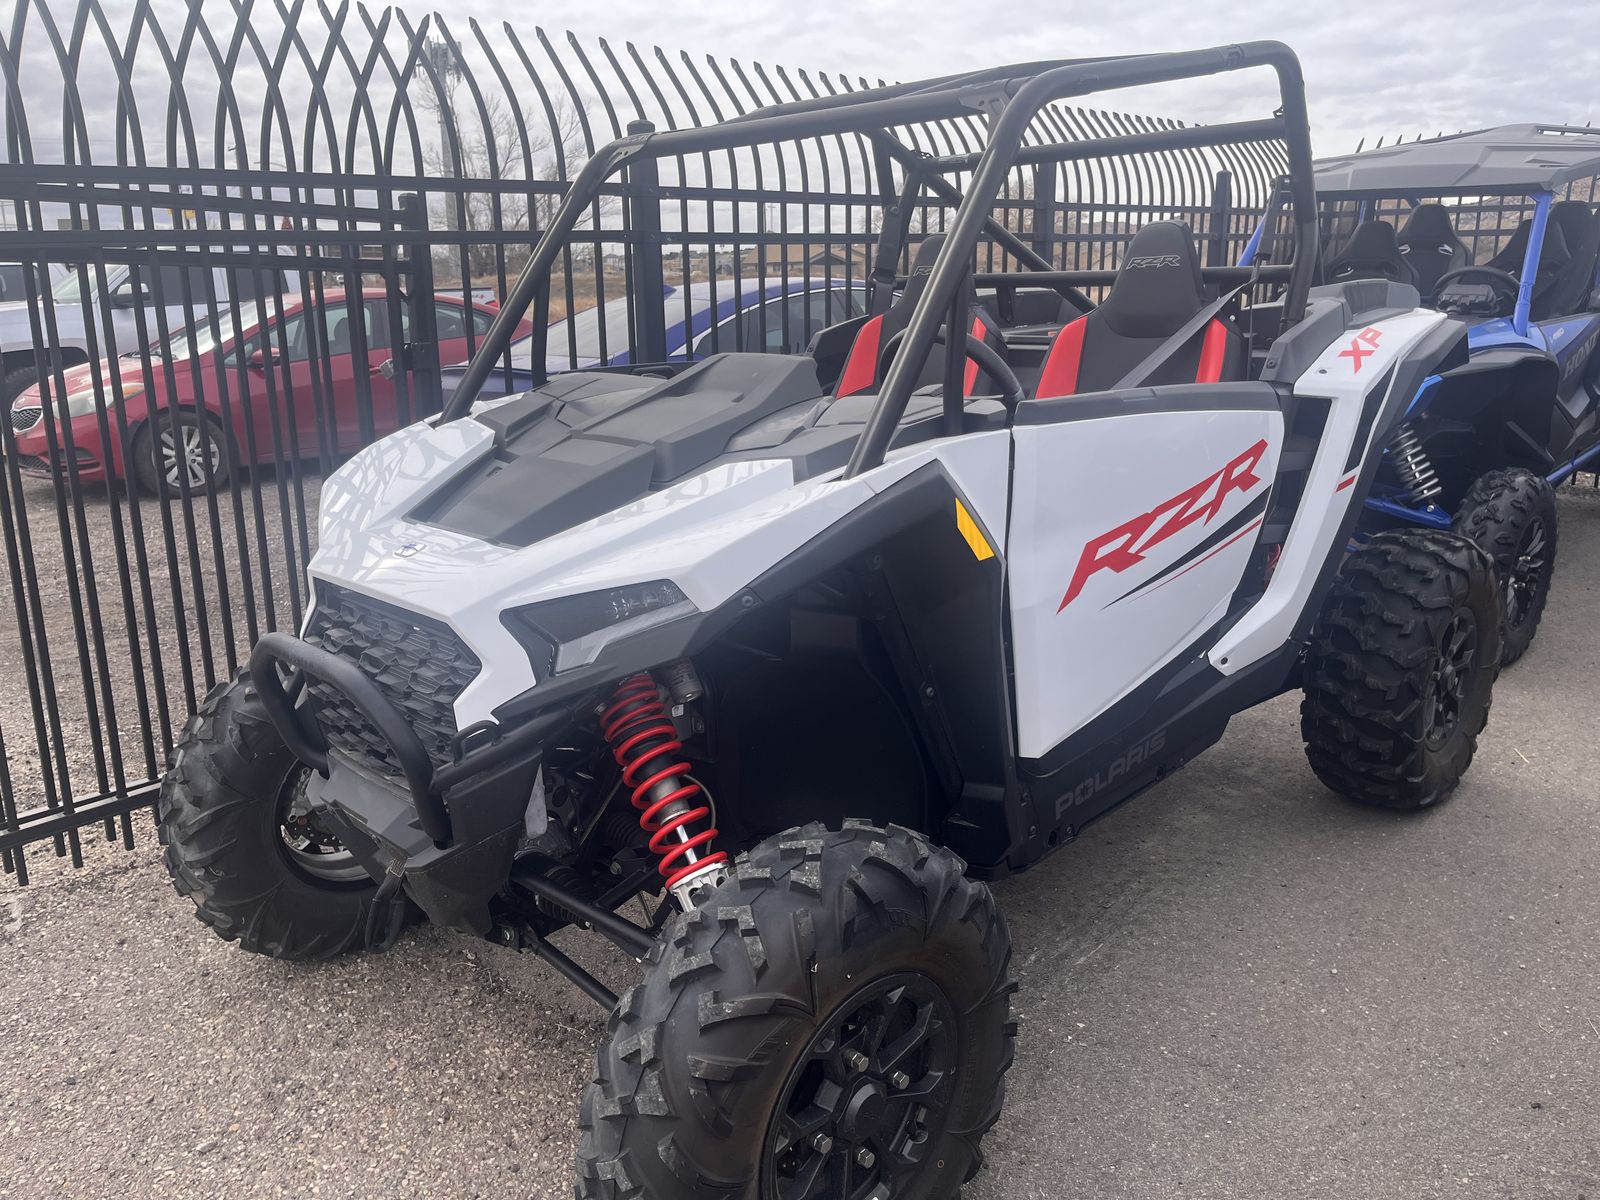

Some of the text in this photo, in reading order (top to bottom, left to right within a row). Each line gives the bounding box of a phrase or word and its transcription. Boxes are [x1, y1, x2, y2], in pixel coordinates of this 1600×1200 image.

[1126, 255, 1181, 270] RZR
[1338, 327, 1383, 376] XP
[1056, 438, 1269, 616] RZR
[1055, 729, 1167, 821] POLARIS
